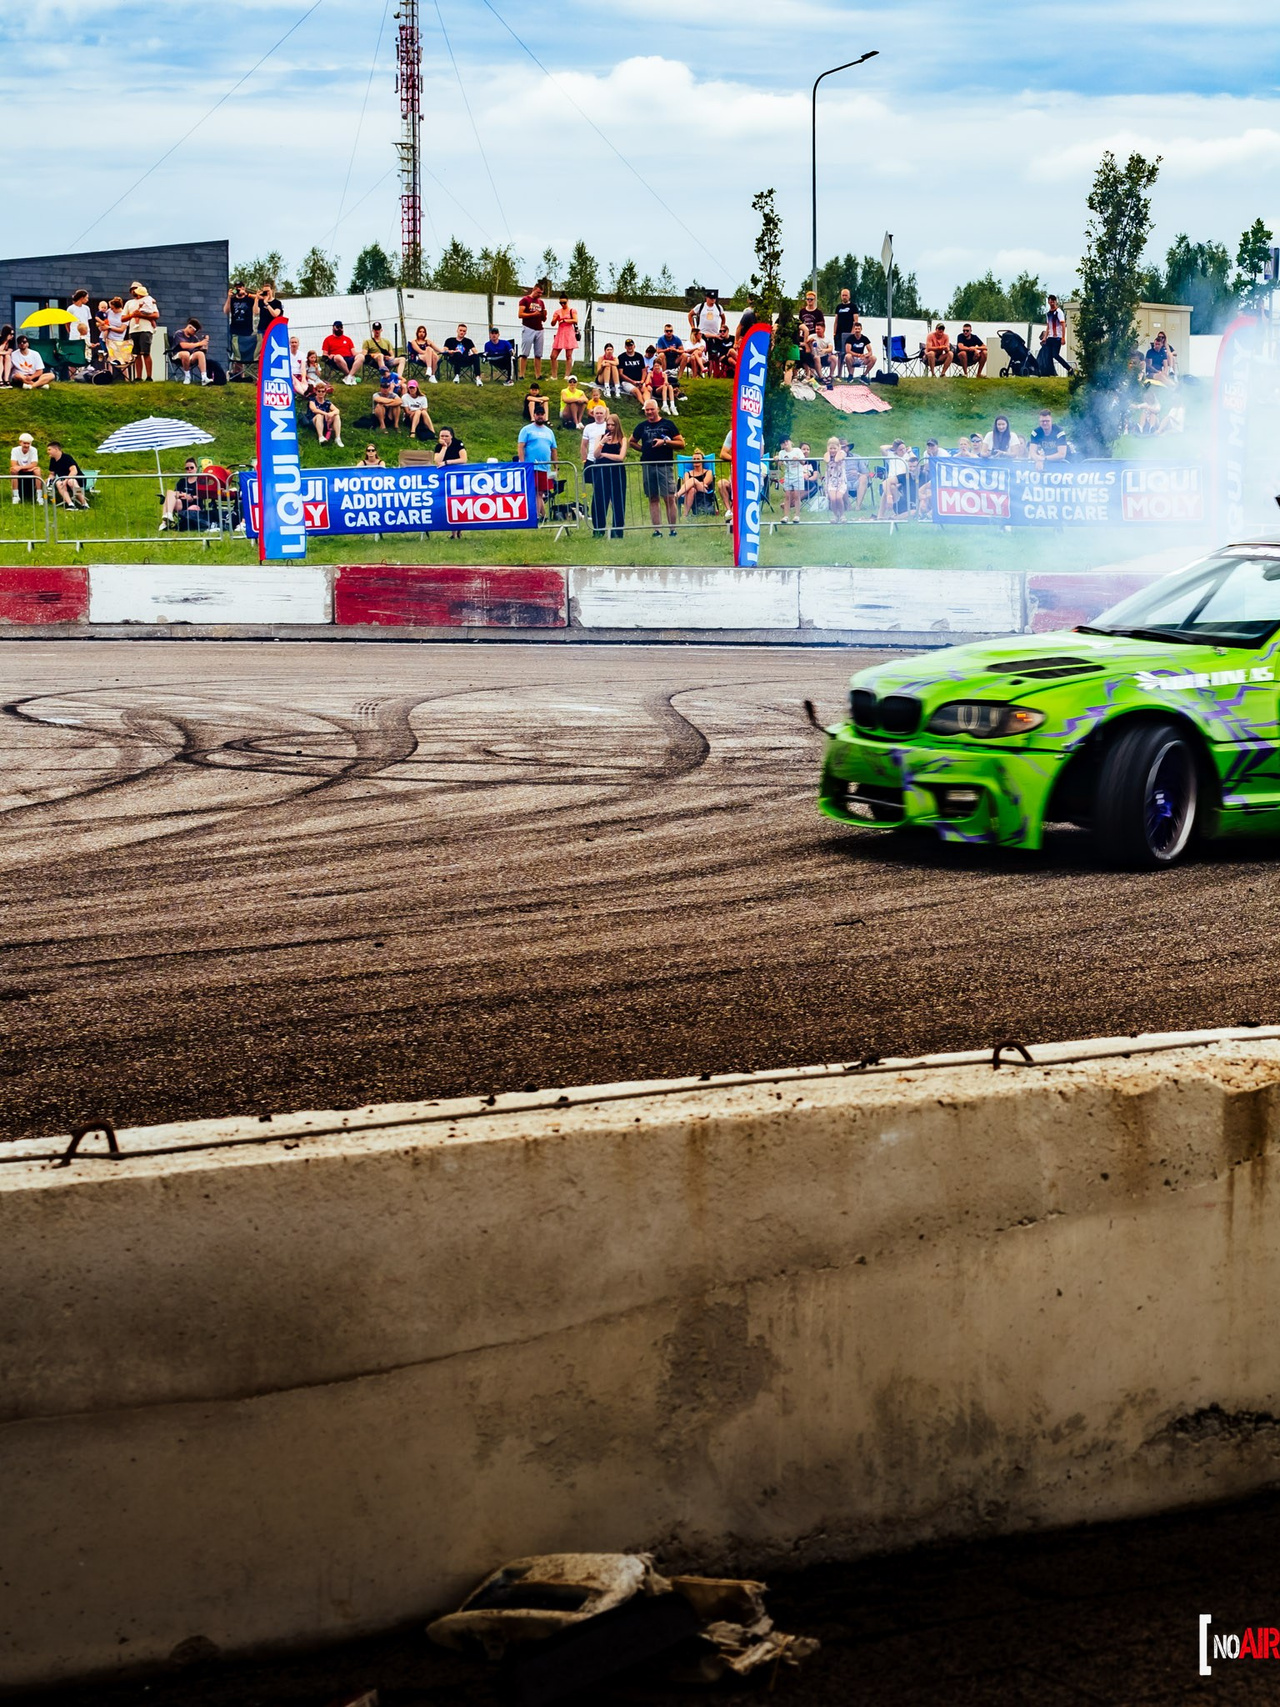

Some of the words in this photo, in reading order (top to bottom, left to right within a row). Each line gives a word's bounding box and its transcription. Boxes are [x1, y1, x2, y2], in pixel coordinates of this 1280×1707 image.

[742, 386, 760, 399] LIQUI
[741, 398, 760, 413] MOLY
[334, 476, 396, 492] MOTOR
[399, 474, 439, 490] OILS
[449, 471, 522, 496] LIQUI
[940, 465, 1006, 491] LIQUI
[1016, 470, 1074, 485] MOTOR
[1077, 471, 1116, 485] OILS
[1125, 469, 1198, 494] LIQUI
[273, 455, 305, 554] LIQUI
[340, 491, 433, 510] ADDITIVES
[941, 490, 1008, 517] MOLY
[1021, 487, 1109, 503] ADDITIVES
[451, 496, 526, 520] MOLY
[745, 461, 760, 565] LIQUI
[1024, 504, 1058, 520] CAR
[1062, 504, 1109, 520] CARE
[1127, 494, 1201, 519] MOLY
[344, 510, 381, 527] CAR
[385, 509, 432, 526] CARE
